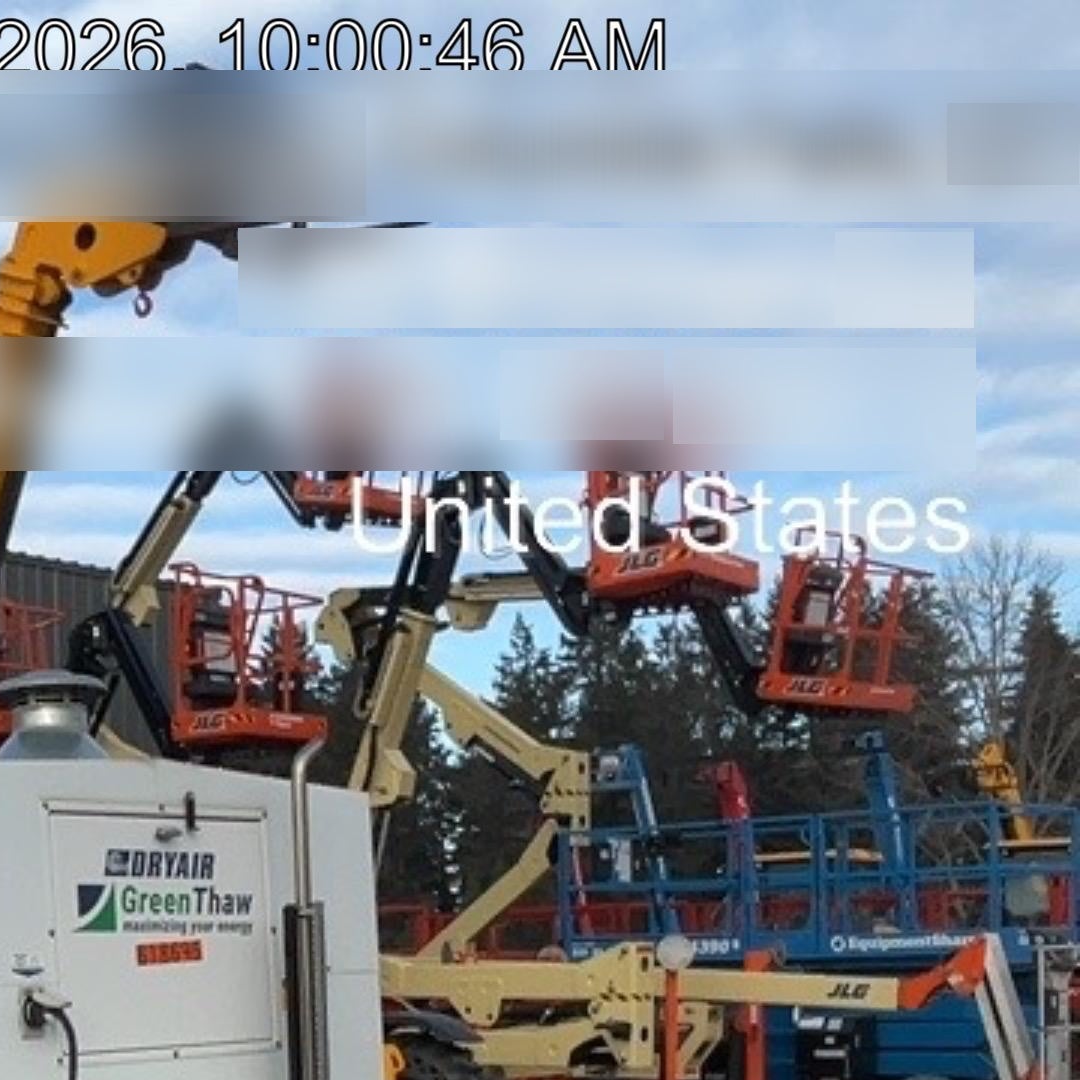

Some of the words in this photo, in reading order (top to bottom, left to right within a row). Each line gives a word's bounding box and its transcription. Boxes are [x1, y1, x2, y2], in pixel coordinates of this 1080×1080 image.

[617, 549, 658, 573] JLG
[130, 850, 216, 880] DRYAIR
[122, 884, 253, 916] GreenThaw
[191, 922, 214, 936] your
[827, 983, 871, 999] JLG
